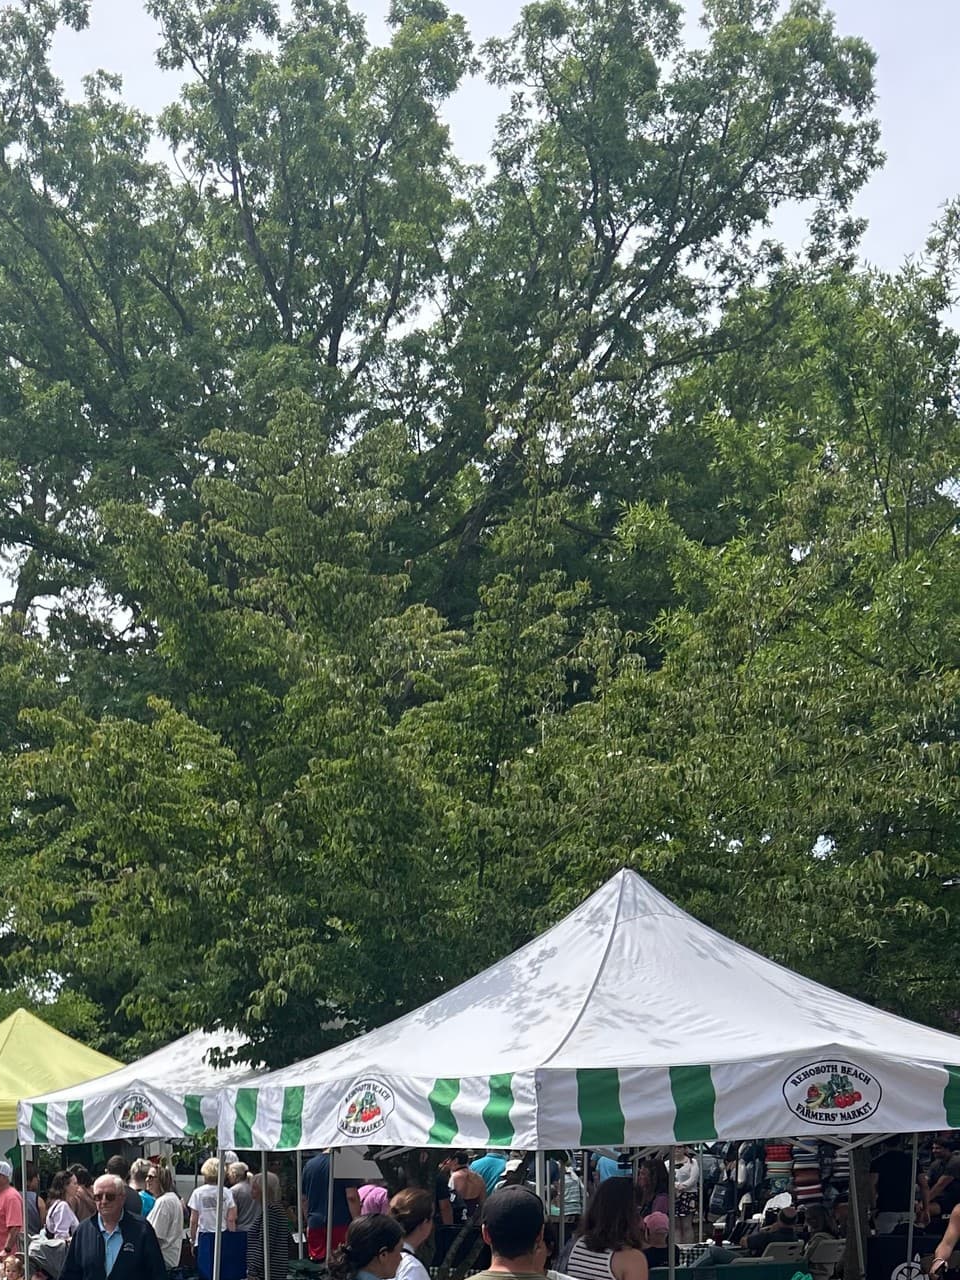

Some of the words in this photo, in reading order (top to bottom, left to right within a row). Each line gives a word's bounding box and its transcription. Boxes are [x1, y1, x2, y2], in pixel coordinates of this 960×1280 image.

[790, 1064, 838, 1087] REHOBOTH
[840, 1065, 872, 1086] BEACH
[795, 1103, 838, 1122] FARMERS'
[840, 1102, 873, 1121] MARKET
